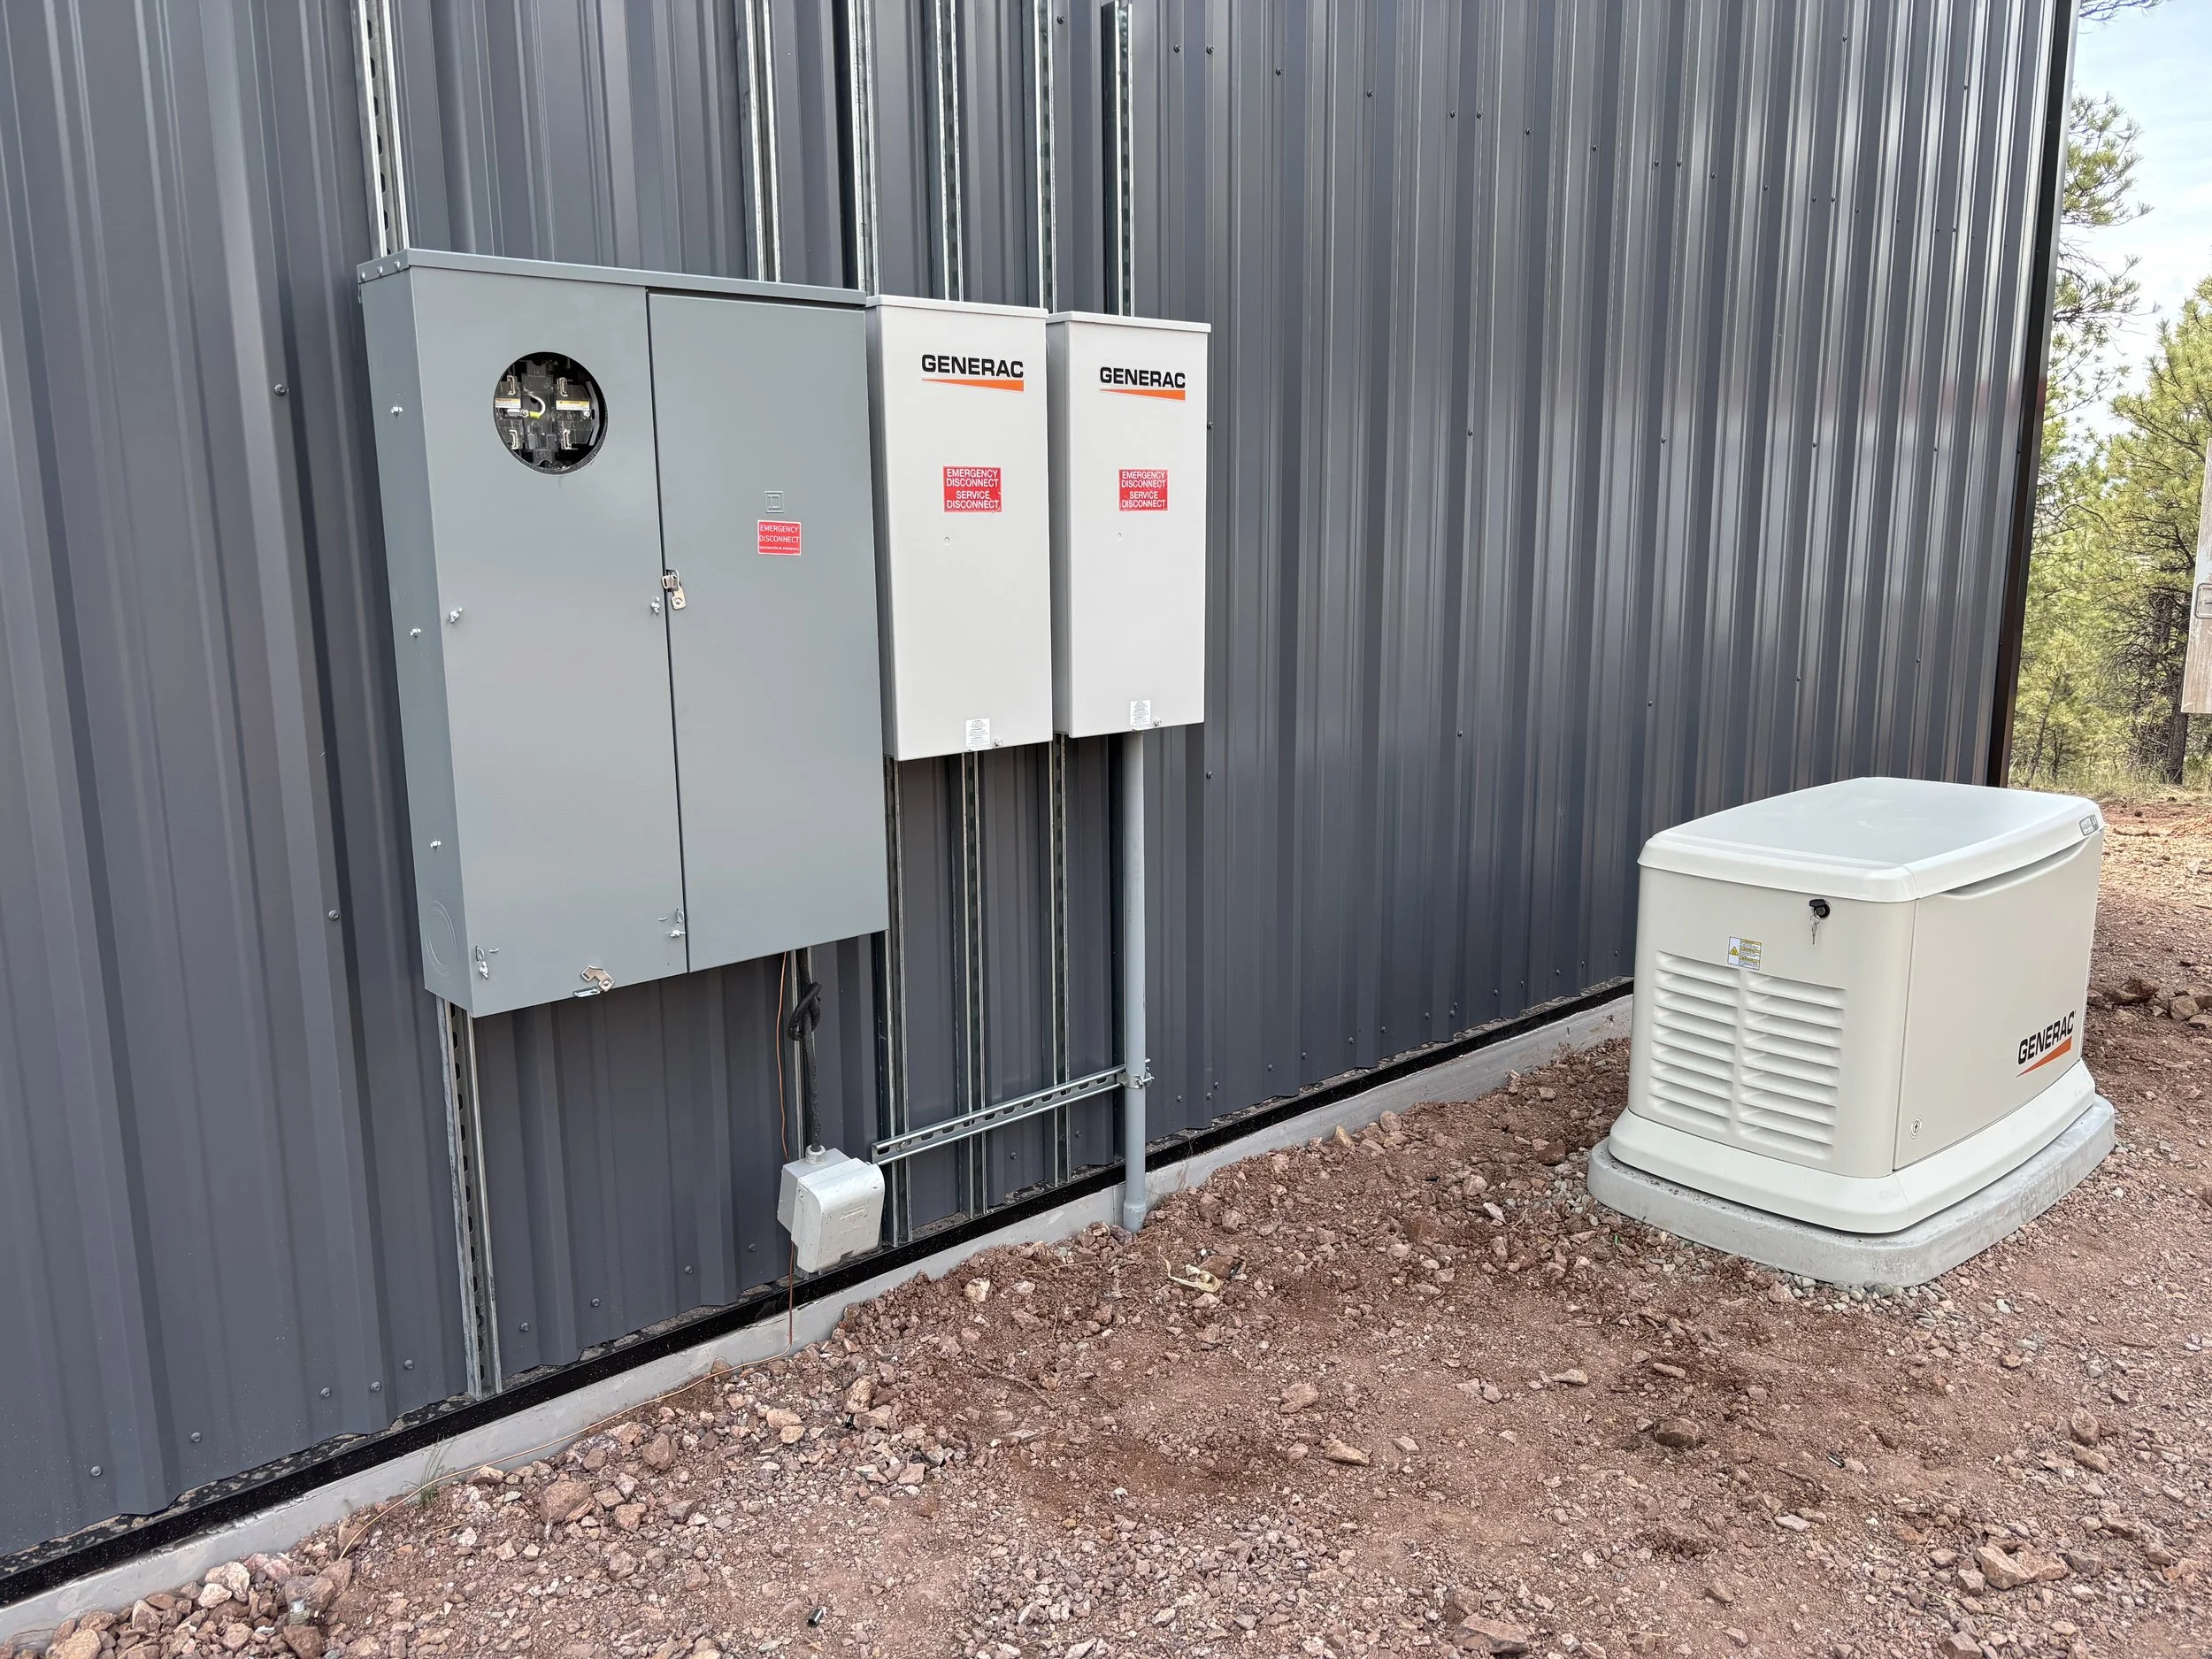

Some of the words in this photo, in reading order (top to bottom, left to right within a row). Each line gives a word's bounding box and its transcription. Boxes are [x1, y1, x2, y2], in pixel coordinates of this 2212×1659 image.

[921, 354, 1025, 379] GENERAC
[1099, 366, 1186, 388] GENERAC
[947, 468, 998, 478] EMERGENCY
[1121, 471, 1165, 480] EMERGENCY
[946, 478, 999, 487] DISCONNECT
[1121, 480, 1166, 488] DISCONNECT
[956, 490, 991, 500] SERVICE
[1129, 491, 1159, 500] SERVICE
[947, 499, 1000, 509] DISCONNECT
[1121, 499, 1166, 508] DISCONNECT
[759, 524, 799, 533] EMERGENCY
[758, 534, 800, 543] DISCONNECT
[2017, 1010, 2075, 1065] GENERAC
